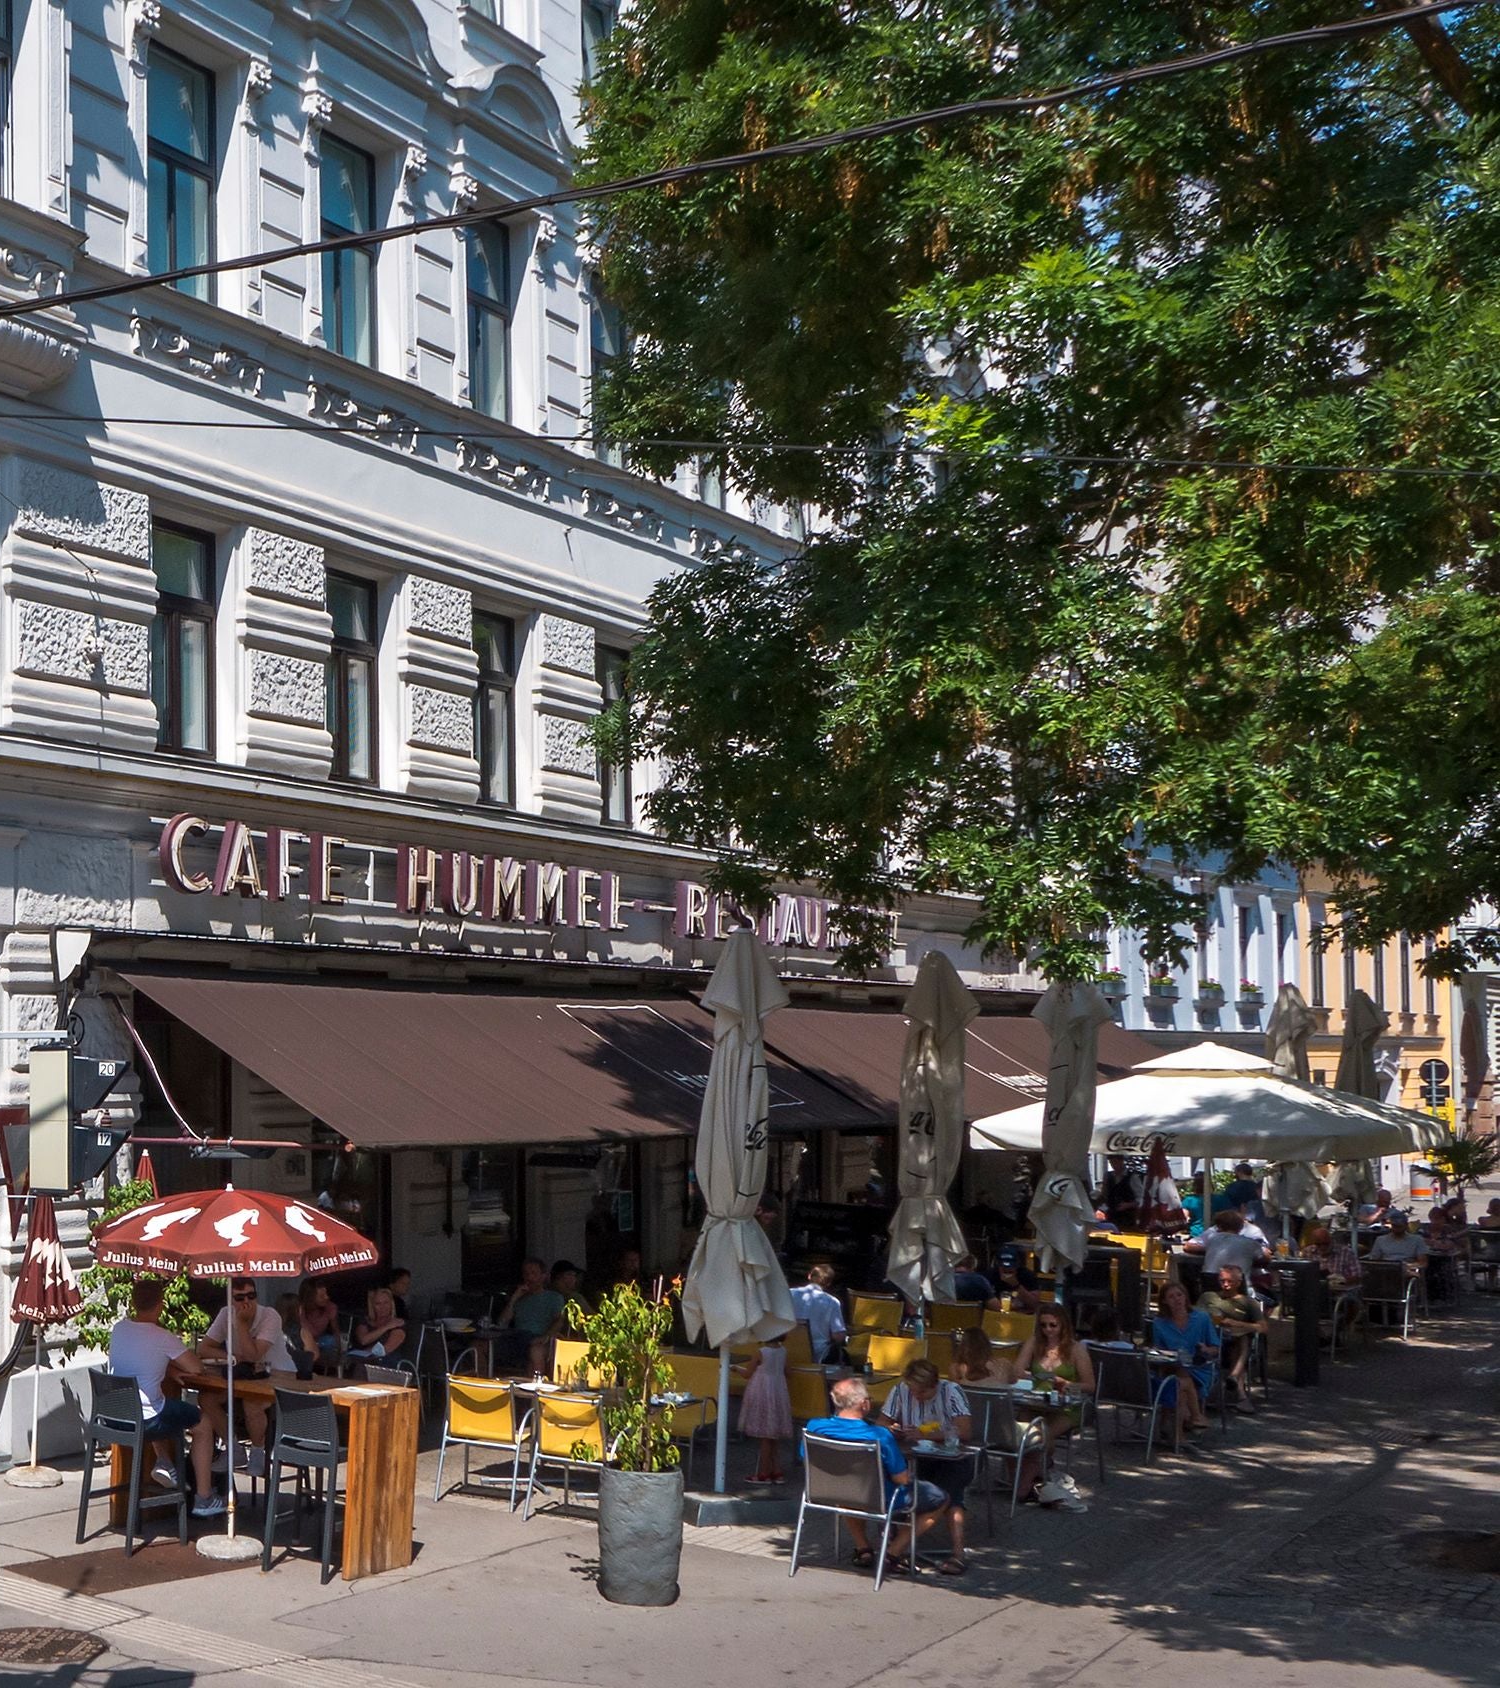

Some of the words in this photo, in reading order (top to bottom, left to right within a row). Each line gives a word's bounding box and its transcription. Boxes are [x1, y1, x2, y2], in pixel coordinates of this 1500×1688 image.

[397, 843, 629, 931] HUMMEL
[675, 879, 906, 950] RESTAURT
[99, 1063, 115, 1075] 20
[98, 1133, 111, 1145] 17
[1106, 1131, 1177, 1153] Coca-Cla
[103, 1251, 144, 1267] Julius
[147, 1256, 178, 1272] Meinl
[194, 1262, 244, 1275] Julius
[249, 1260, 295, 1272] Meinl
[309, 1256, 339, 1272] Julius
[339, 1249, 373, 1265] Meinl
